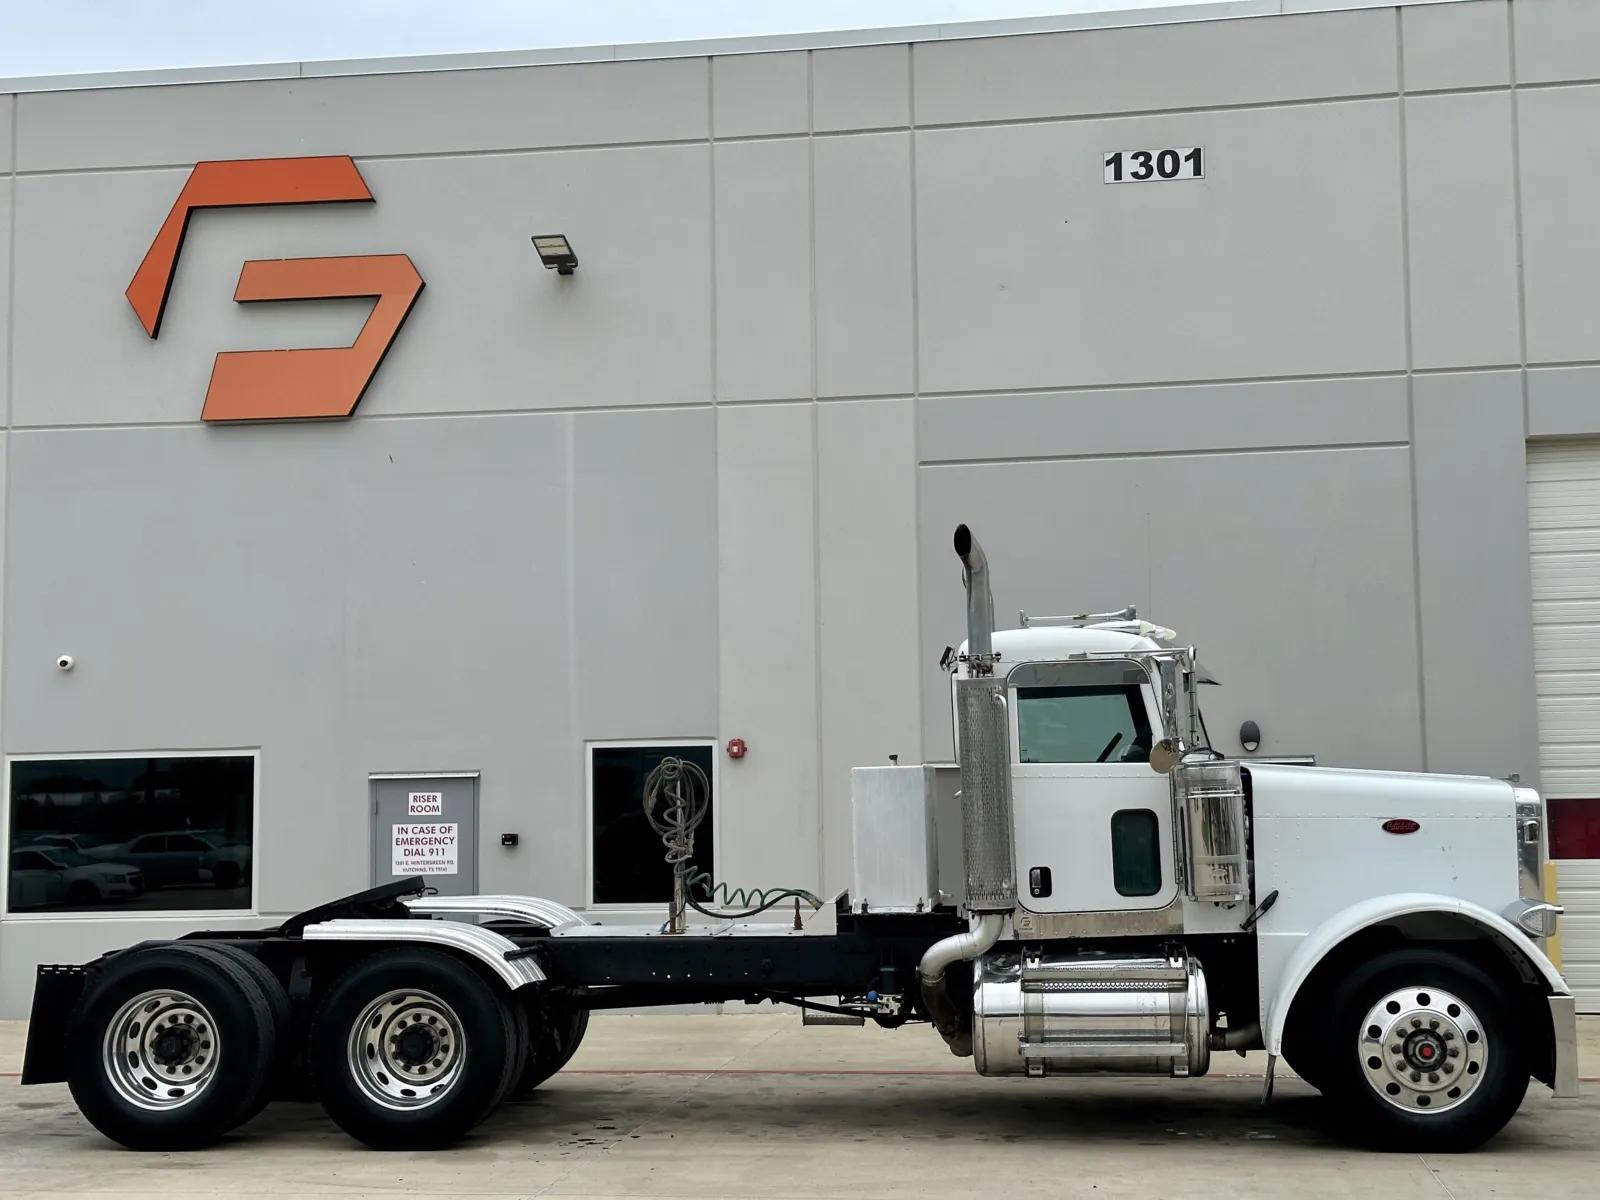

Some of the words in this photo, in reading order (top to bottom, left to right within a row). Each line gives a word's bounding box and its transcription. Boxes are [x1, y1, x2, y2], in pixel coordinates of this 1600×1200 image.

[1105, 147, 1202, 181] 1301
[412, 794, 438, 803] RISER
[410, 804, 440, 813] ROOM
[397, 826, 409, 835] IN
[411, 825, 437, 835] CASE
[439, 825, 453, 834] OF
[395, 836, 455, 846] EMERGENCY
[403, 848, 426, 857] DIAL
[428, 847, 445, 856] 911
